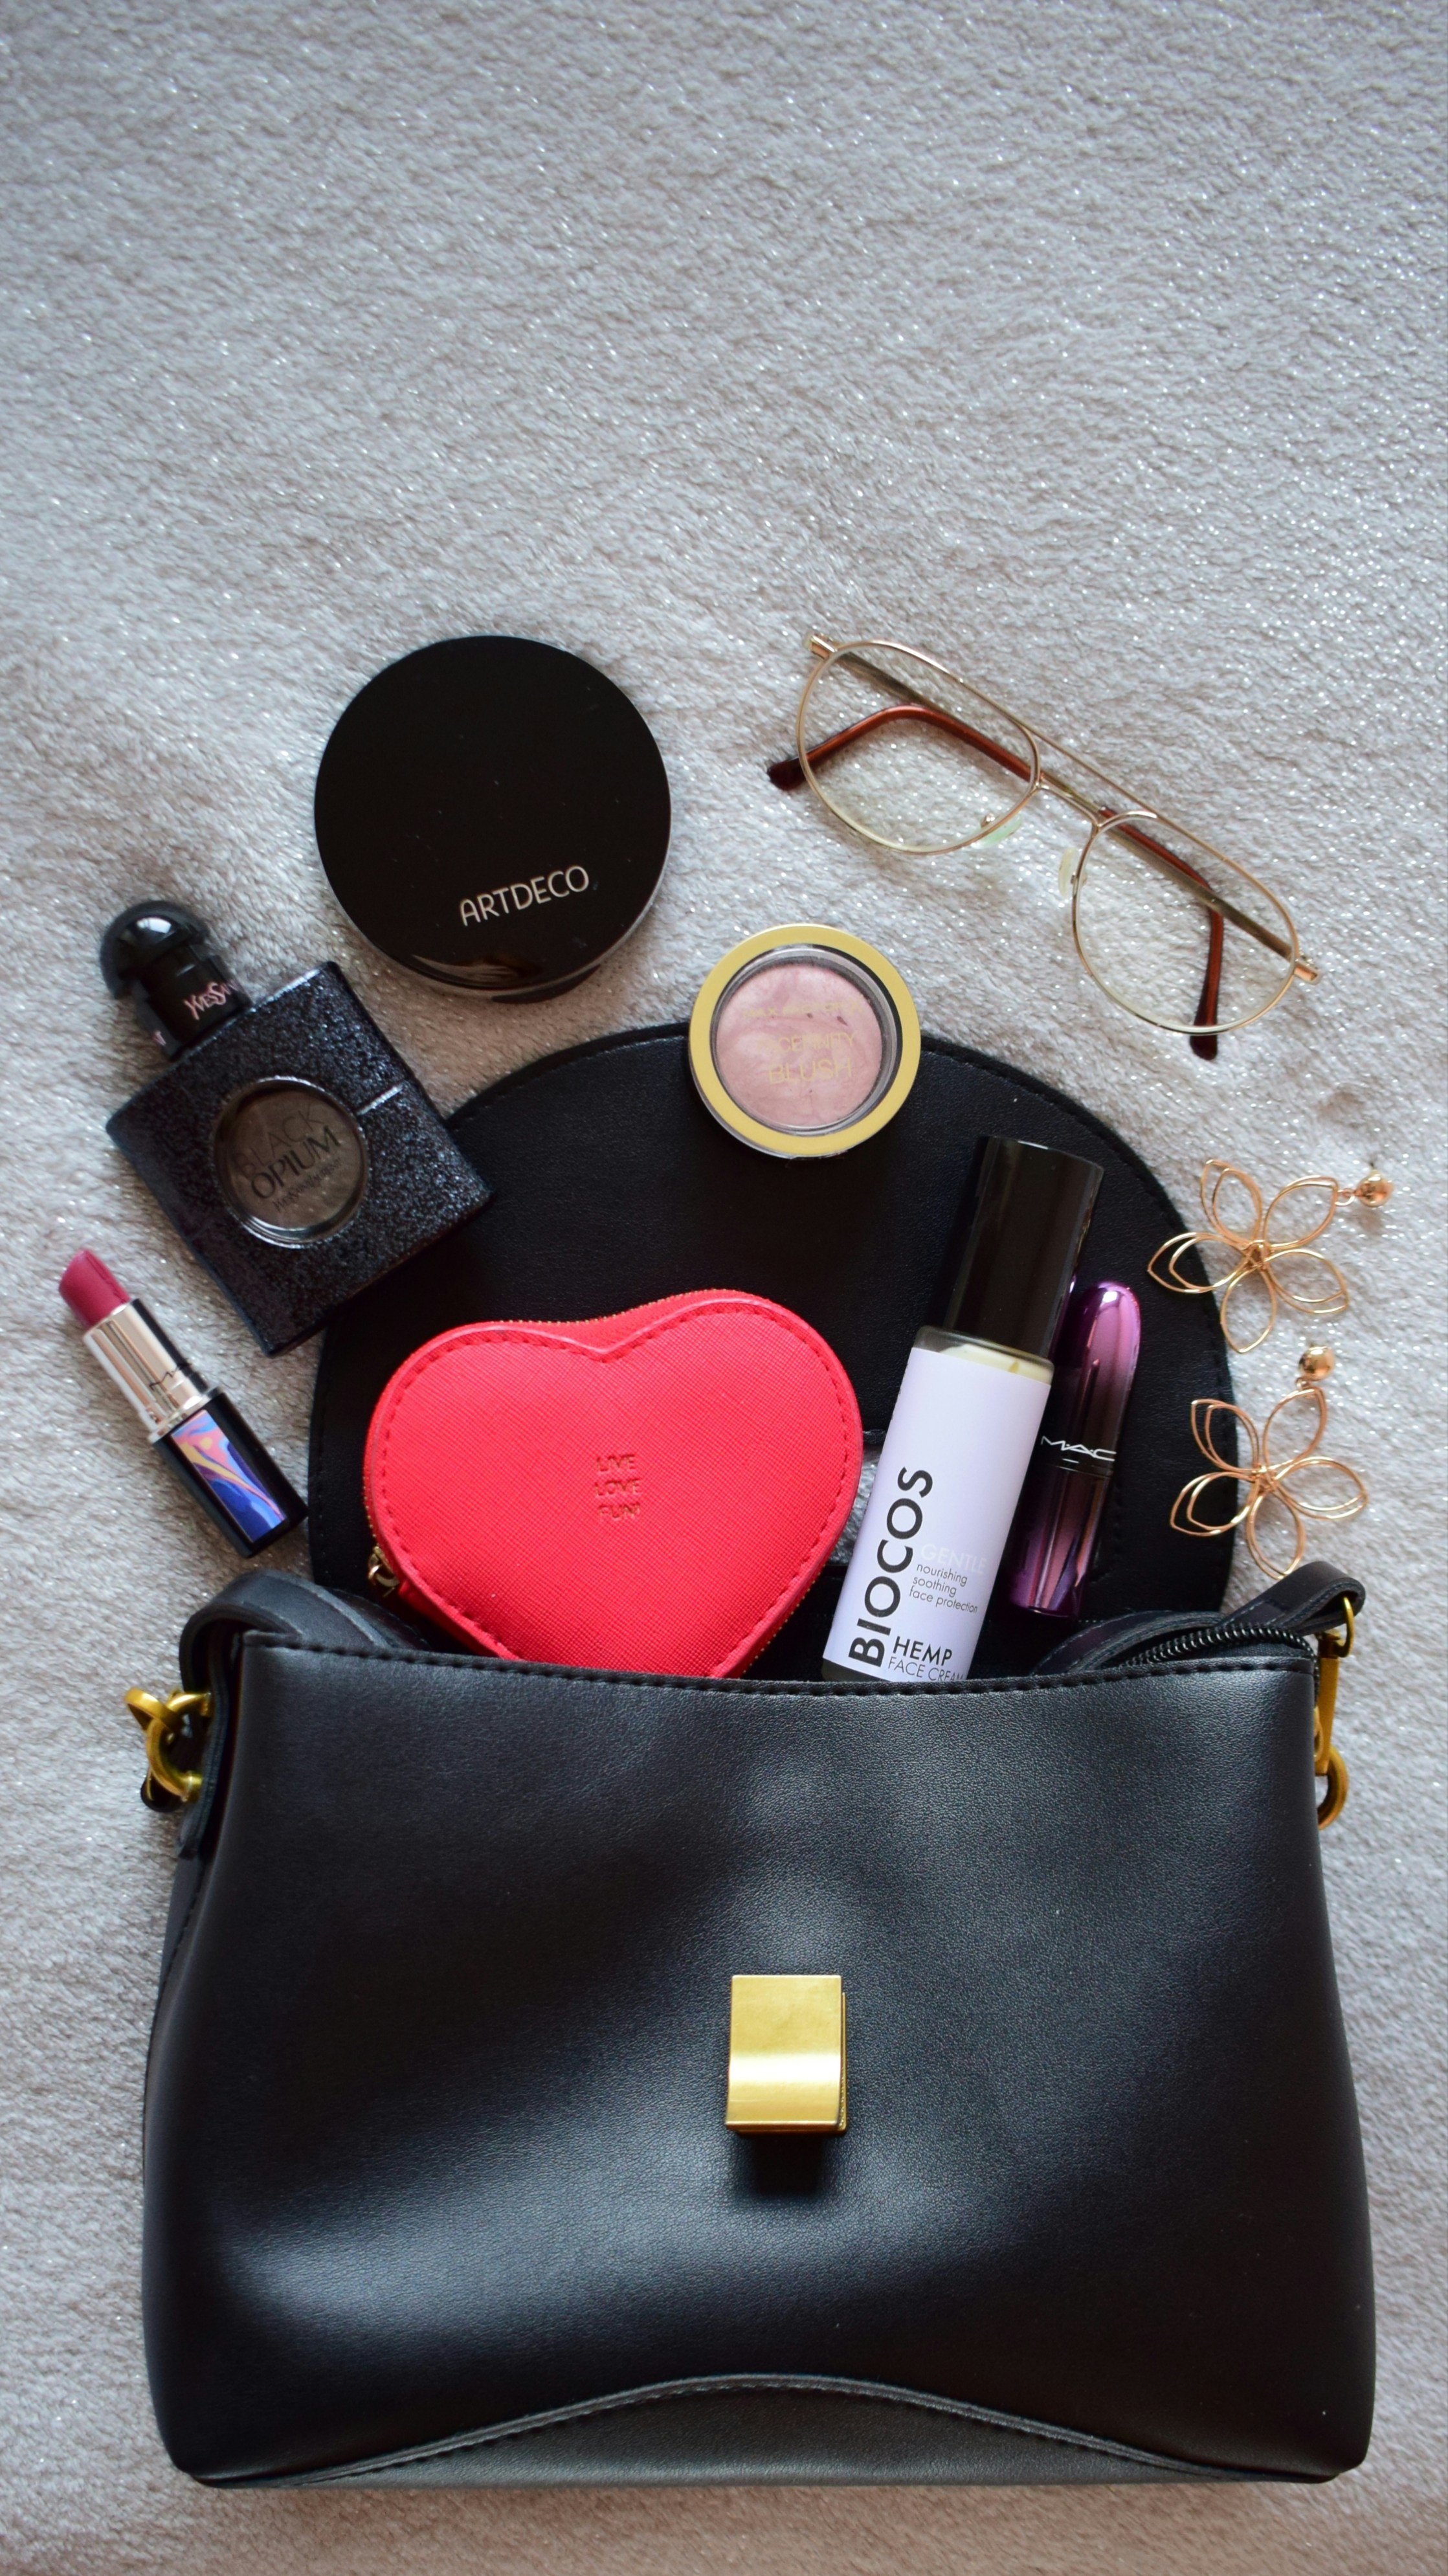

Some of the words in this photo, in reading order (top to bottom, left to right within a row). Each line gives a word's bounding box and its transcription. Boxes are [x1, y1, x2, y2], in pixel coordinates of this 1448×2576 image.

[460, 866, 590, 926] ARTDECO
[768, 1057, 852, 1084] BLUSH
[232, 1103, 324, 1179] BLACK
[251, 1125, 341, 1198] OPIUM
[597, 1454, 636, 1472] LIVE
[595, 1479, 641, 1497] LOVE
[598, 1501, 640, 1519] FUN
[848, 1467, 933, 1667] BIOCOS
[920, 1543, 987, 1575] GENTLE
[913, 1576, 957, 1598] soothing
[917, 1564, 968, 1587] nourishing
[909, 1585, 933, 1602] face
[935, 1595, 978, 1613] protection
[893, 1635, 952, 1666] HEMP
[888, 1656, 926, 1678] FACE
